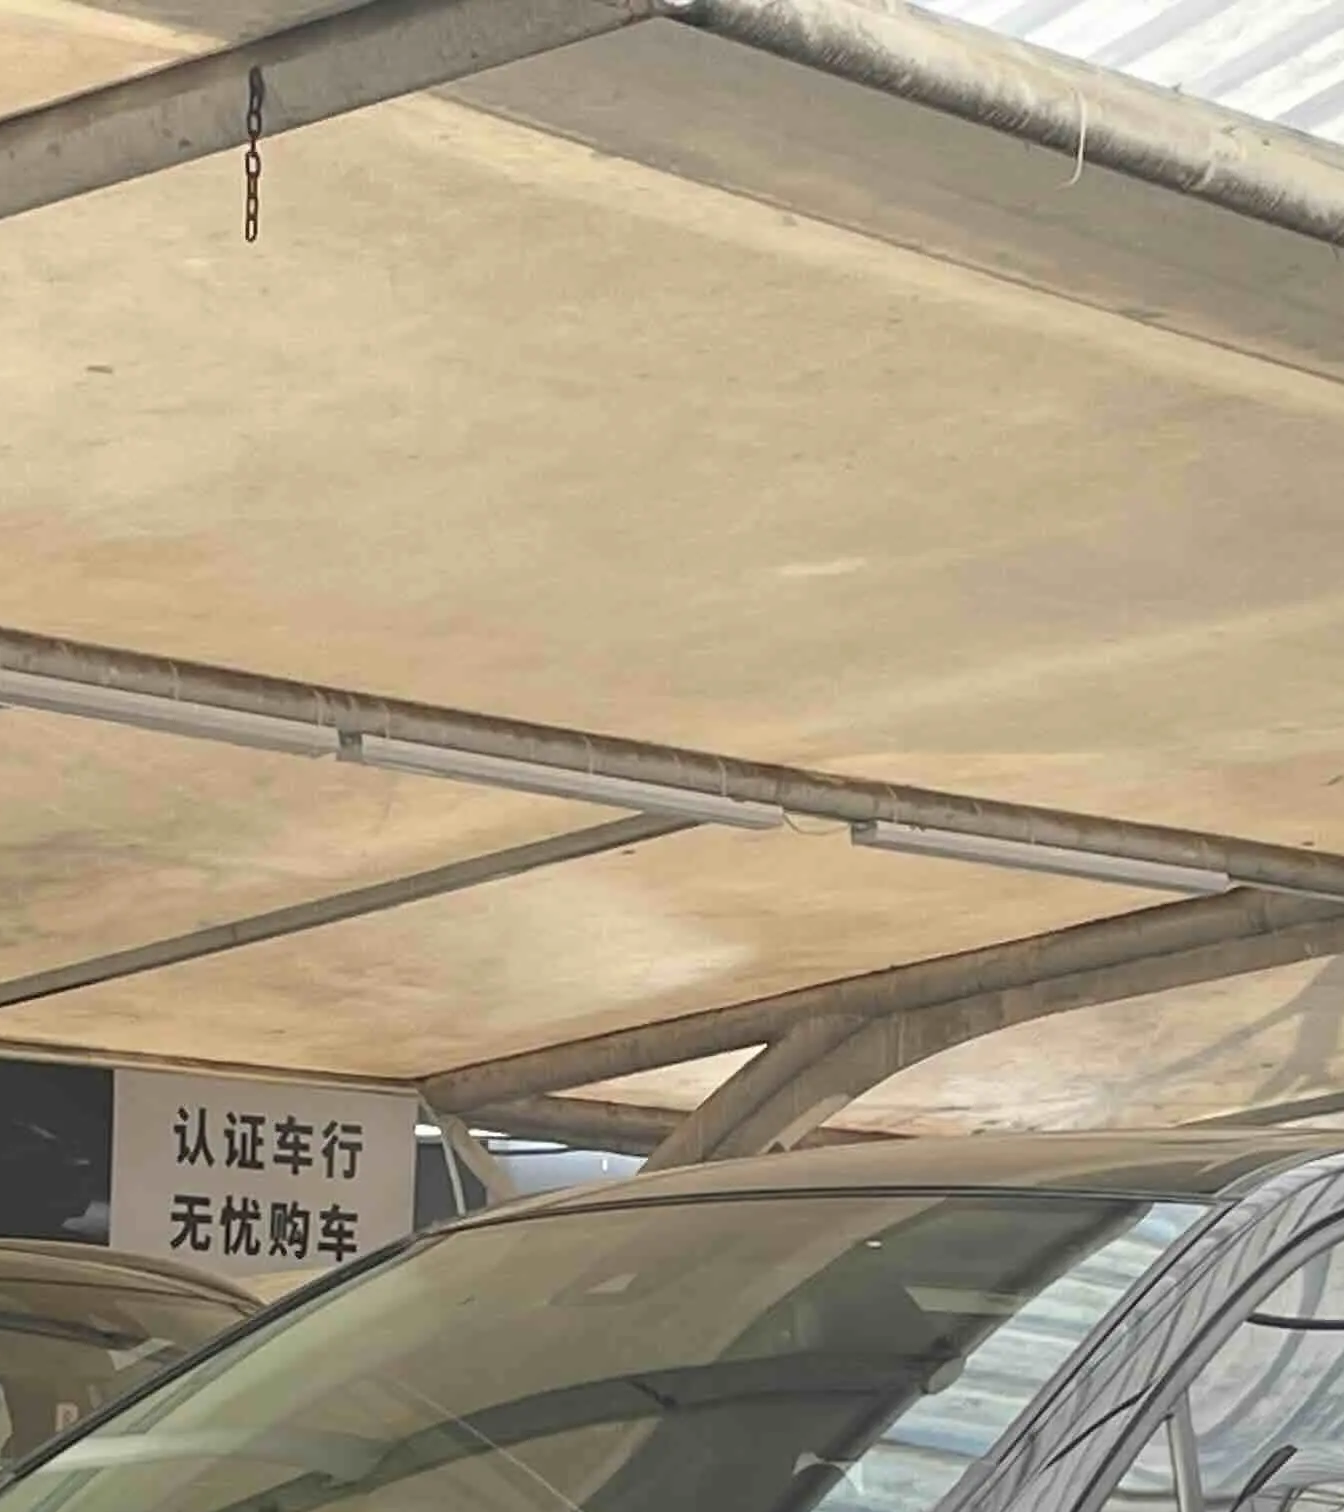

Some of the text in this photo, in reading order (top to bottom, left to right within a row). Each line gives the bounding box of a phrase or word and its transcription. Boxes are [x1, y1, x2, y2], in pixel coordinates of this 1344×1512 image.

[174, 1107, 363, 1179] 认证车行
[170, 1195, 358, 1262] 无忧购车
